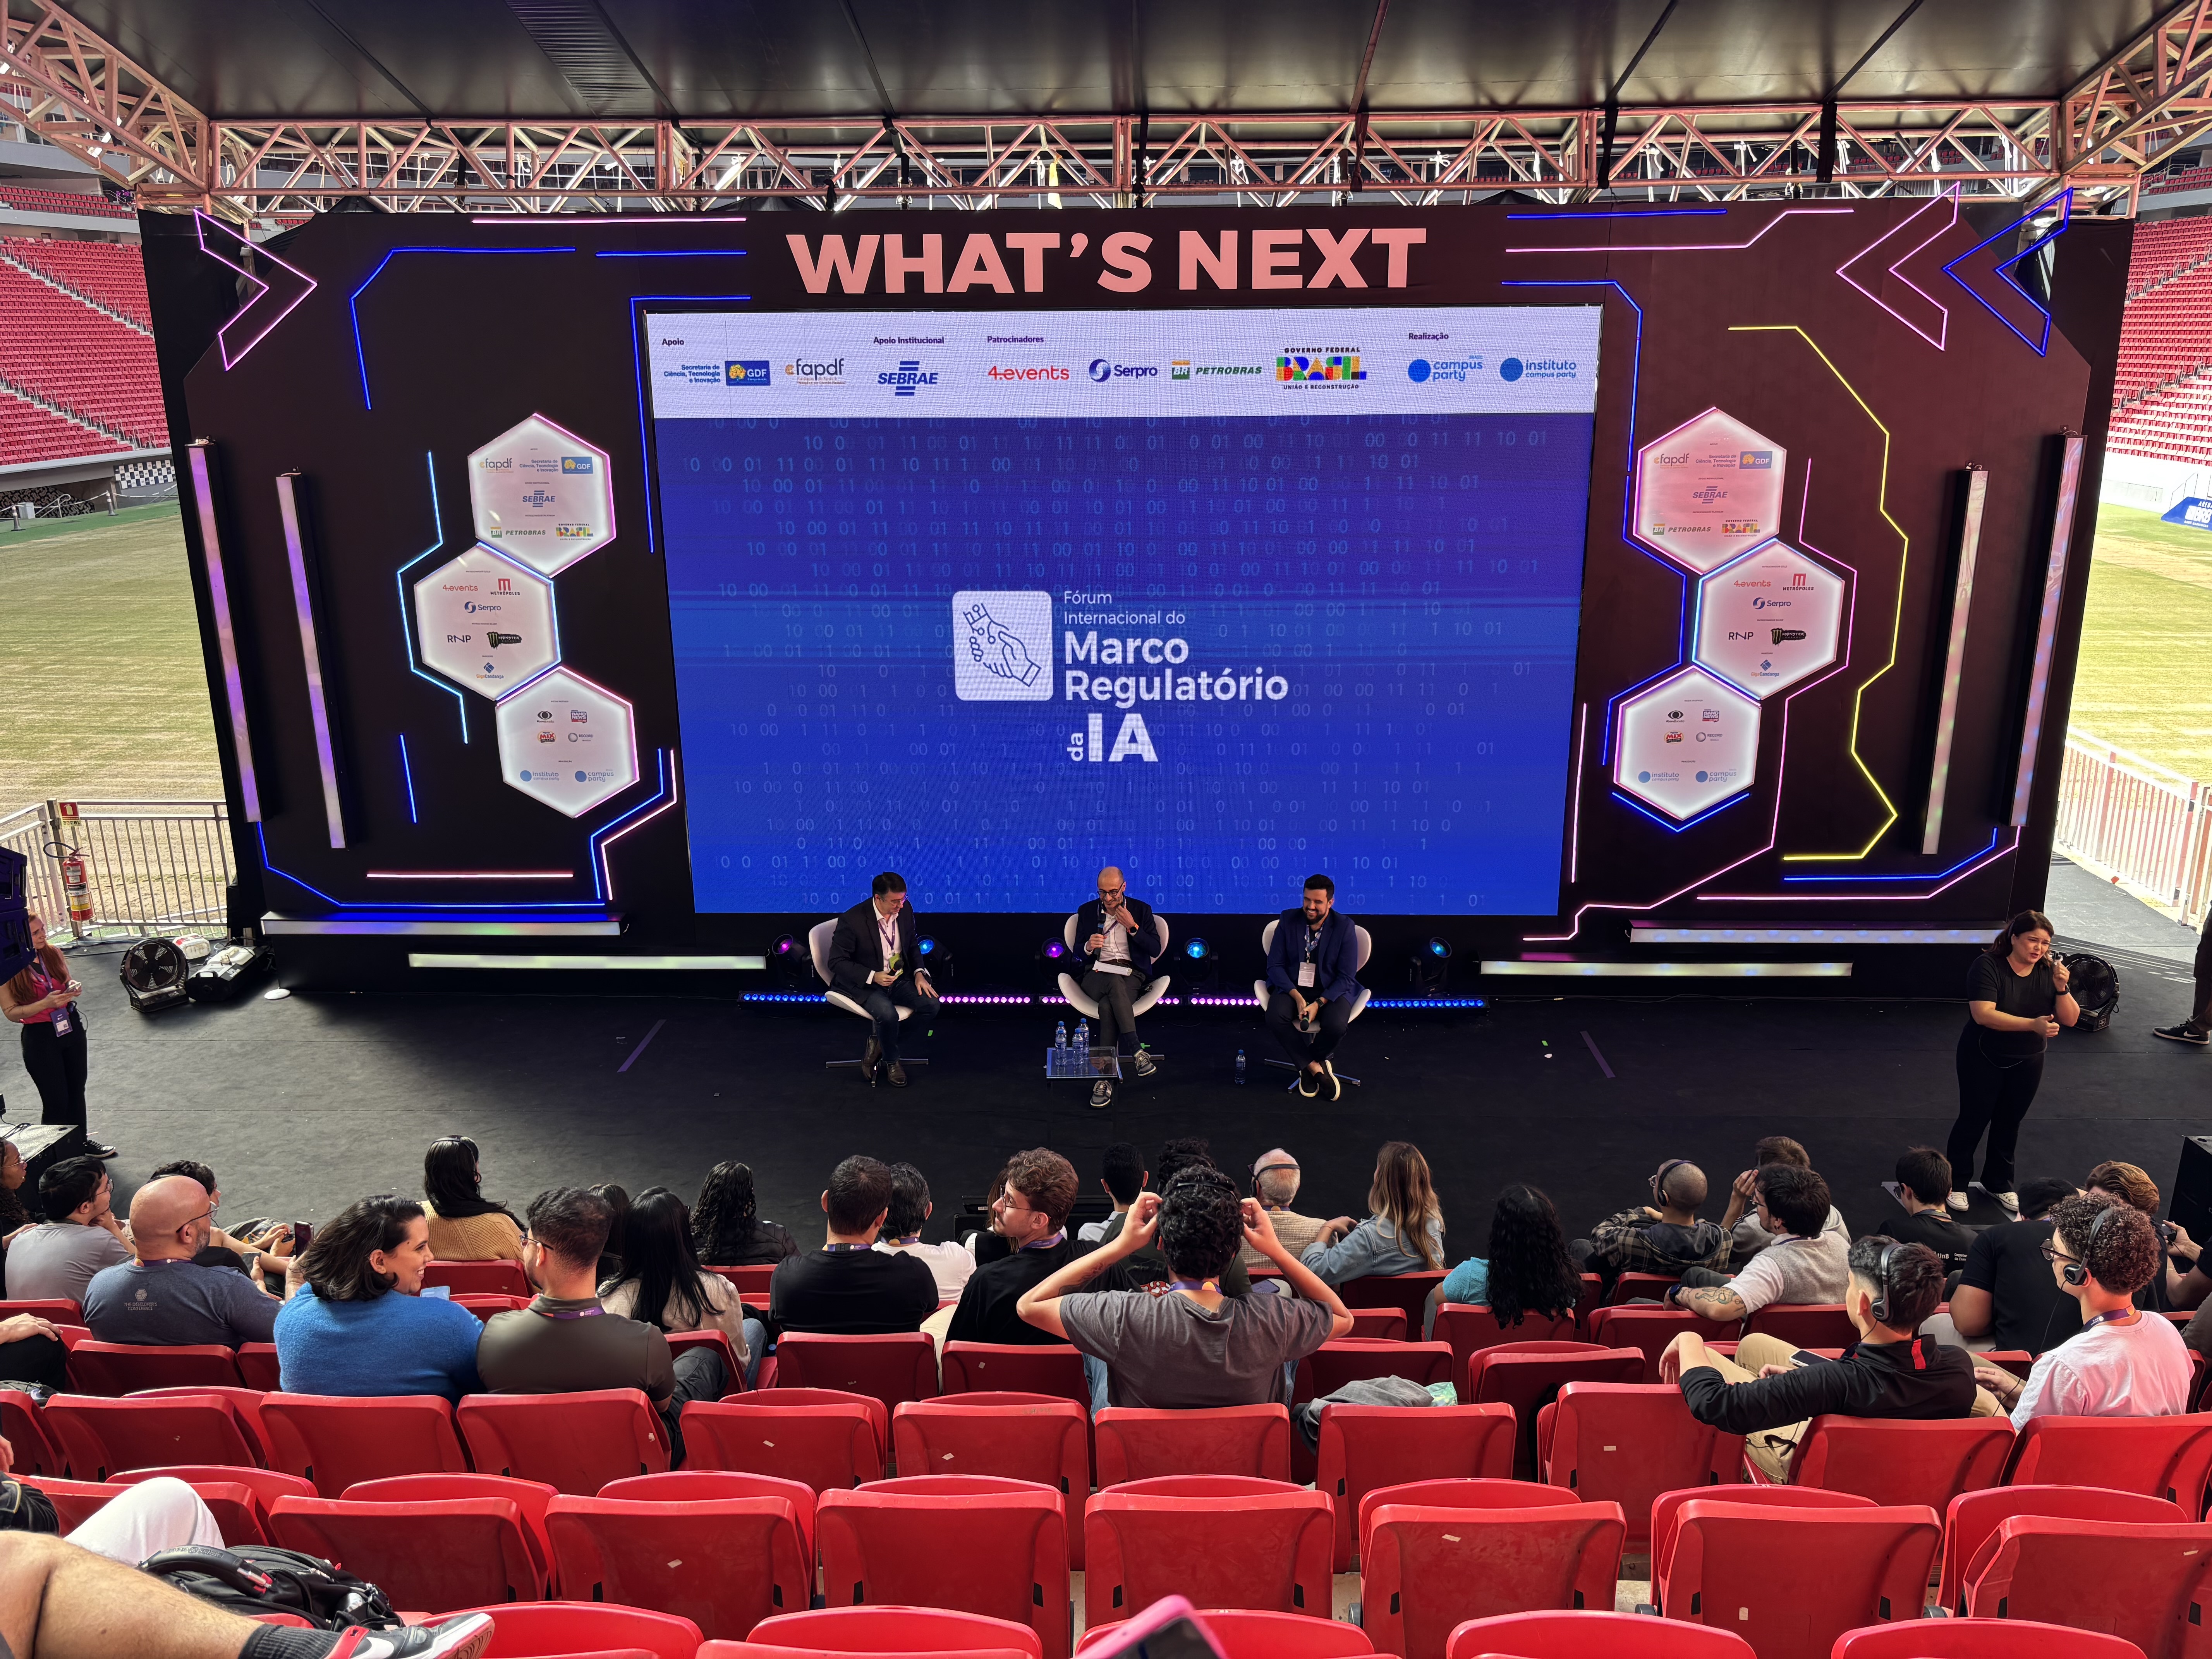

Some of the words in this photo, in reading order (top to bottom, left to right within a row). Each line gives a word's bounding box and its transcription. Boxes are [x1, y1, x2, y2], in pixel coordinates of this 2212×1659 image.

[786, 232, 1153, 294] WHAT'S
[1178, 228, 1426, 290] NEXT
[662, 338, 684, 347] Apoio
[873, 337, 896, 345] Apoio
[1408, 333, 1449, 341] Realização
[1195, 367, 1262, 375] PETROBRAS
[1276, 356, 1367, 381] BRASIL
[1433, 361, 1483, 371] campus
[1525, 360, 1576, 371] instituto
[747, 369, 767, 377] GDF
[1114, 365, 1158, 379] Serpro
[1433, 369, 1465, 382] party
[878, 373, 939, 385] SEBRAE
[556, 527, 594, 537] BRASIL
[1721, 524, 1760, 533] BRASIL
[1064, 590, 1112, 604] Fórum
[1064, 610, 1161, 624] Internacional
[1166, 611, 1185, 624] do
[1728, 632, 1753, 640] RNP
[1065, 630, 1189, 665] Marco
[1066, 668, 1288, 709] Regulatório
[1066, 732, 1084, 760] da
[1088, 713, 1158, 762] IA
